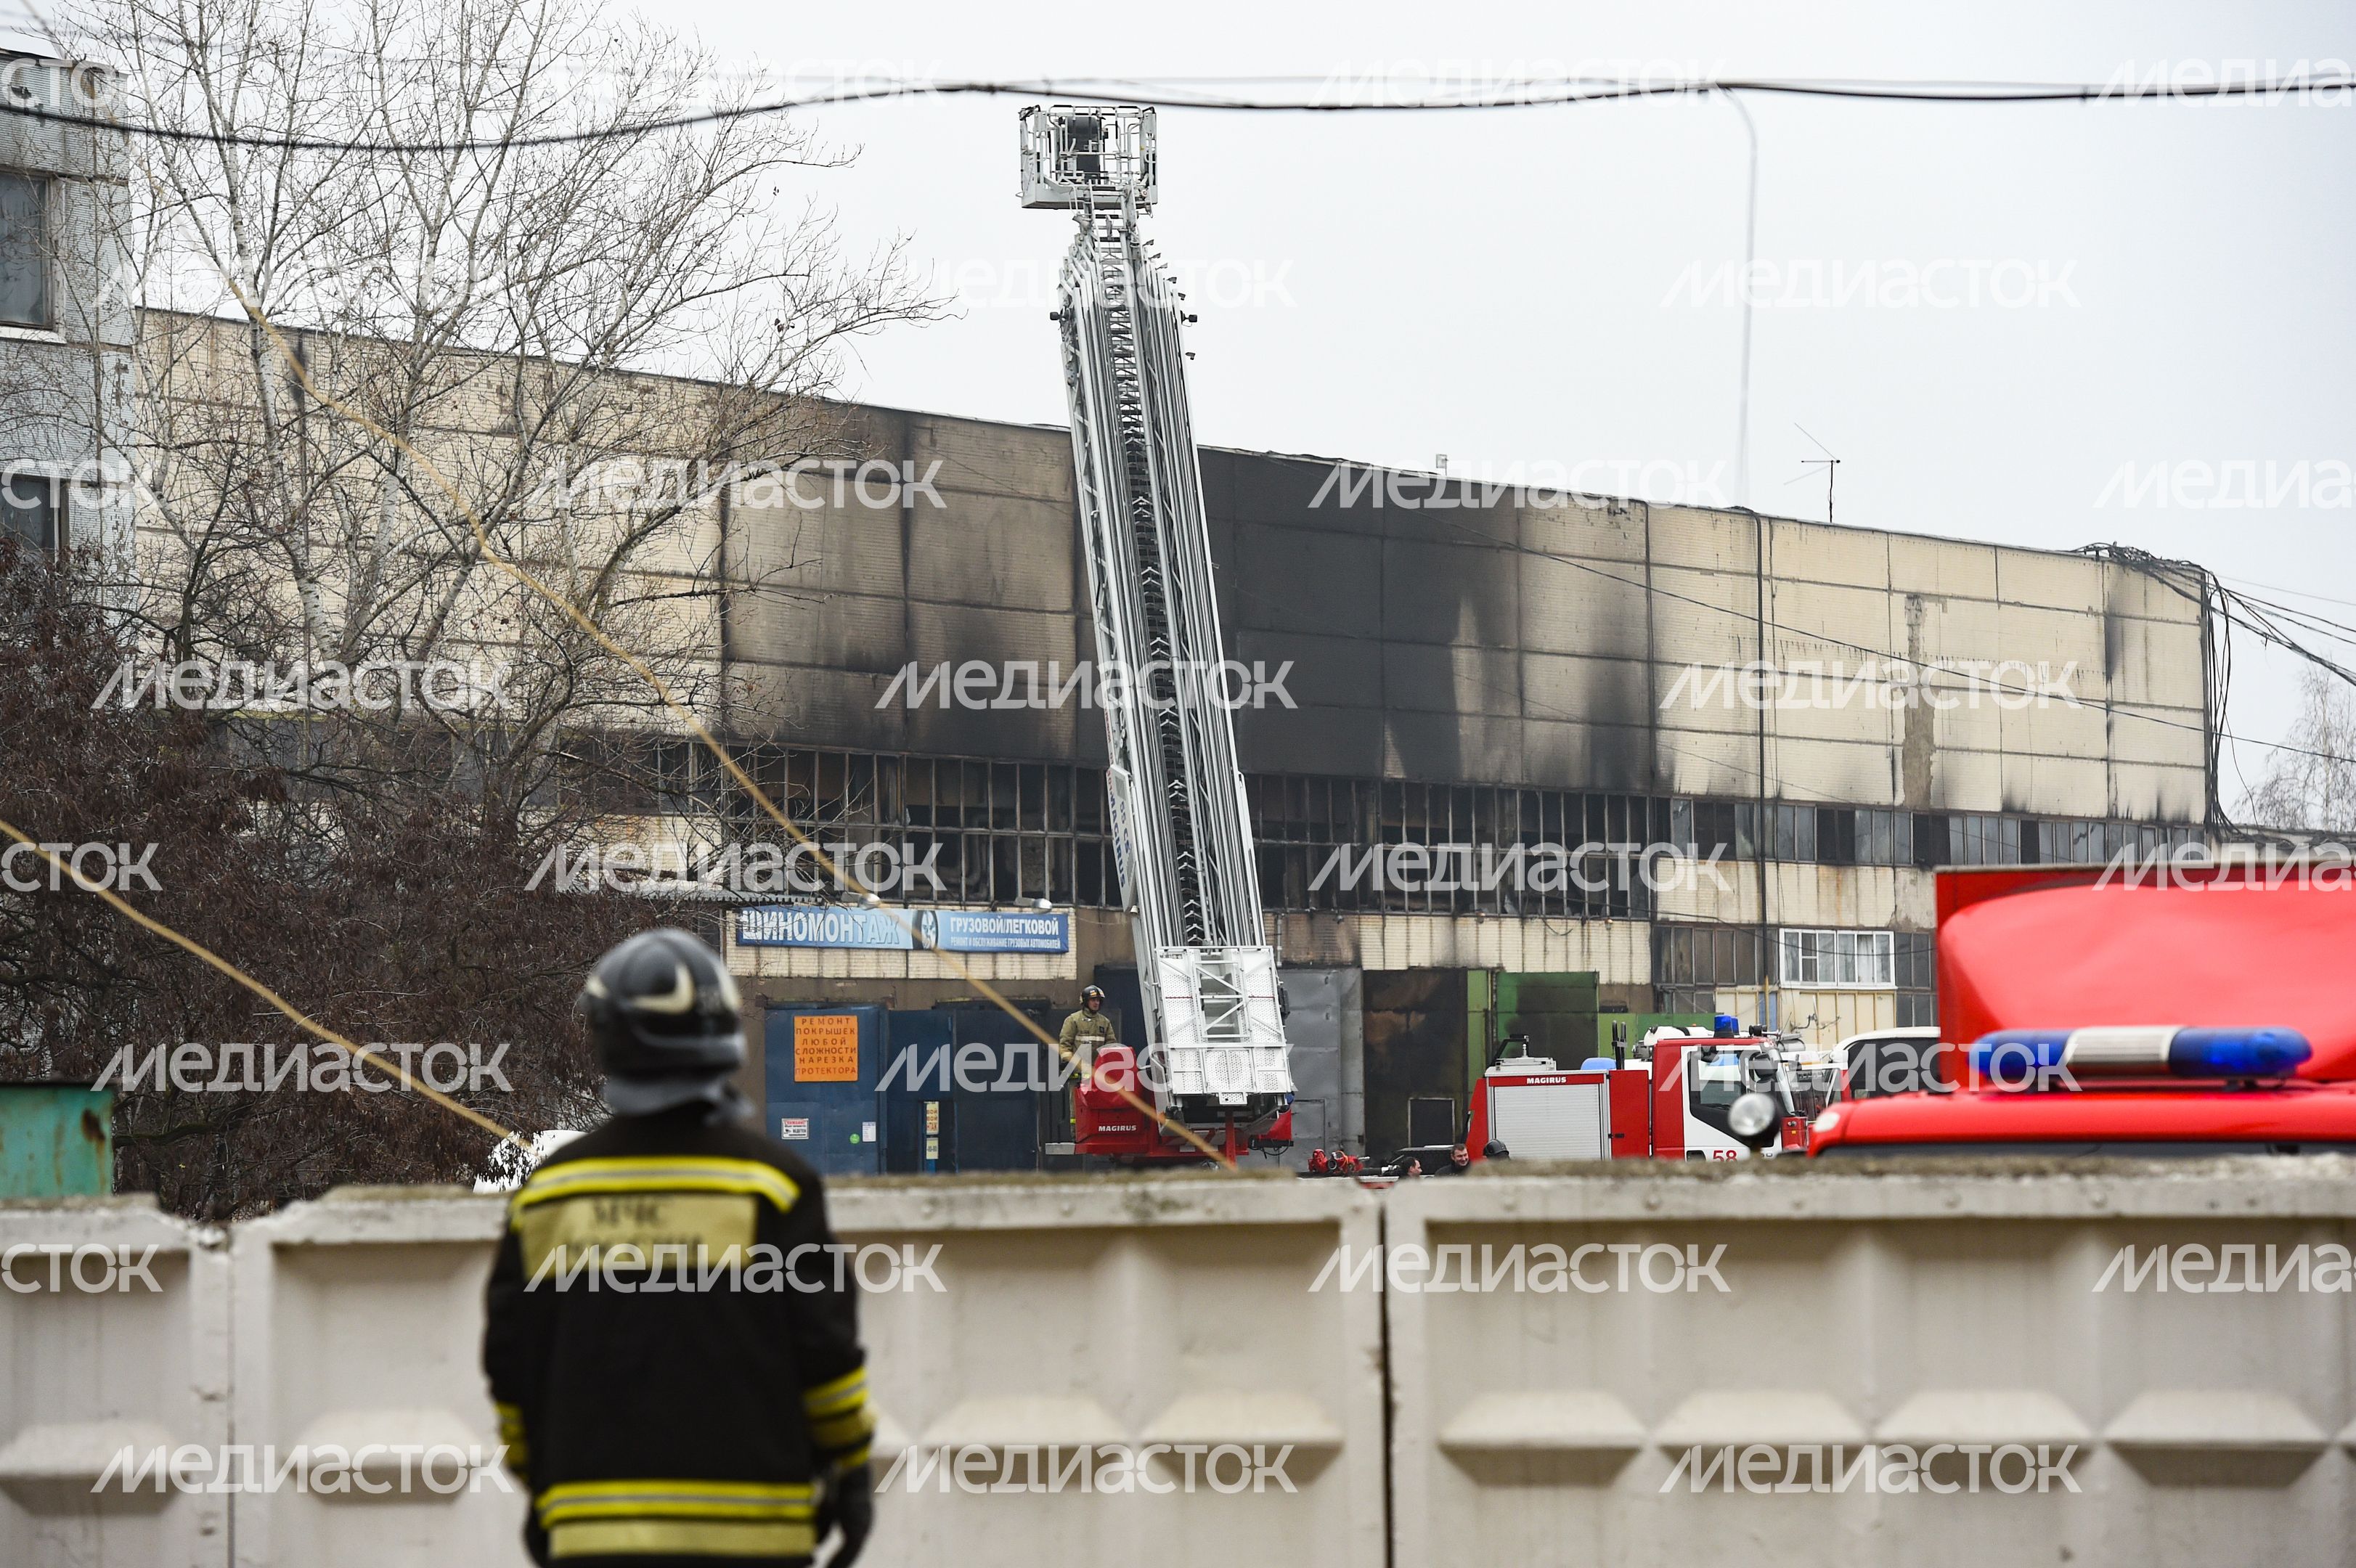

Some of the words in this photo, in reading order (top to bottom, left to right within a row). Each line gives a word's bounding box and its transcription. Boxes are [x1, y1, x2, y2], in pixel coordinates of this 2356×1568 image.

[1110, 795, 1125, 888] MAGIRUS
[740, 910, 900, 944] ШИНОМОНТАЖ
[950, 915, 1059, 935] ГРУЗОВОЙ/ЛЕГКОВОЙ
[1713, 1150, 1737, 1162] 58
